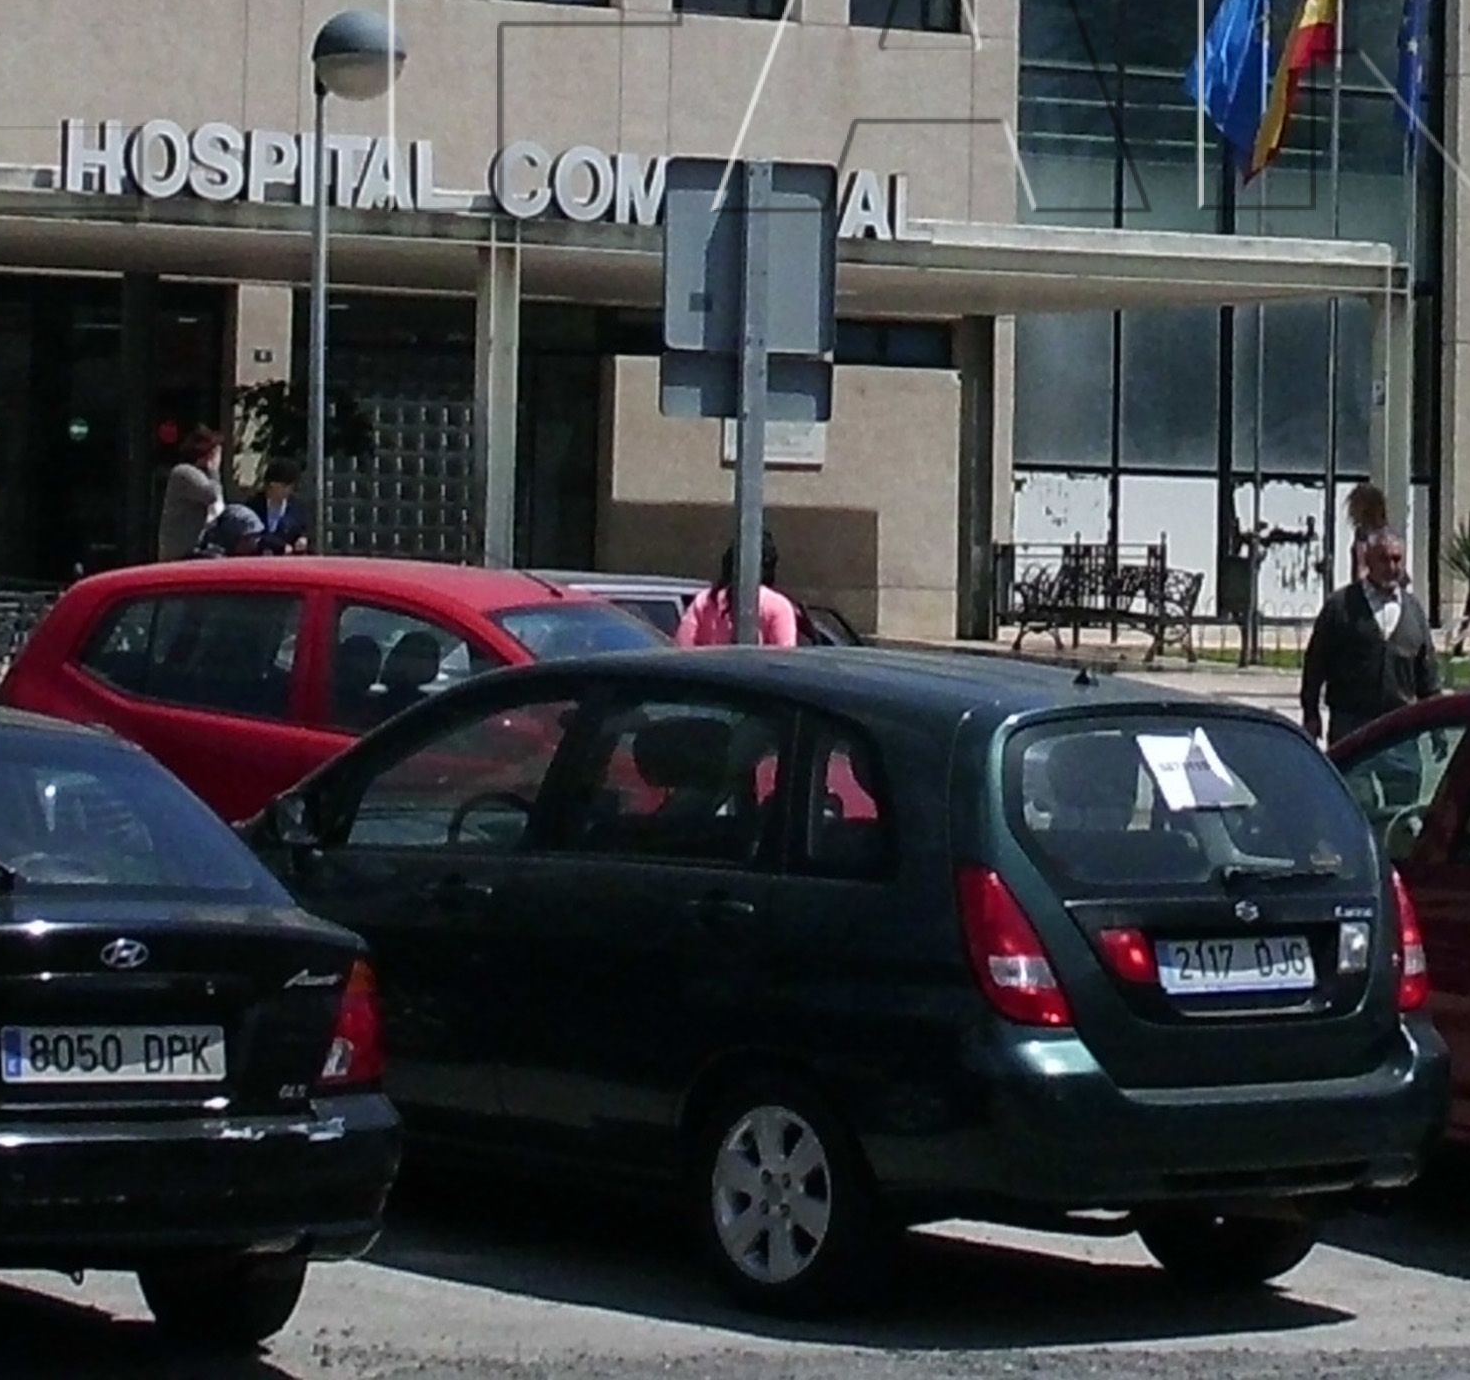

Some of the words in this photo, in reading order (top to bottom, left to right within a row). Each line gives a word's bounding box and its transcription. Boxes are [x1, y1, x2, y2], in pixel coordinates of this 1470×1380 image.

[61, 118, 454, 211] HOSPITAL
[487, 140, 933, 242] COMAL
[1174, 940, 1234, 981] 2117
[1253, 939, 1307, 977] DJG
[29, 1033, 122, 1074] 8050
[144, 1033, 212, 1074] DPK
